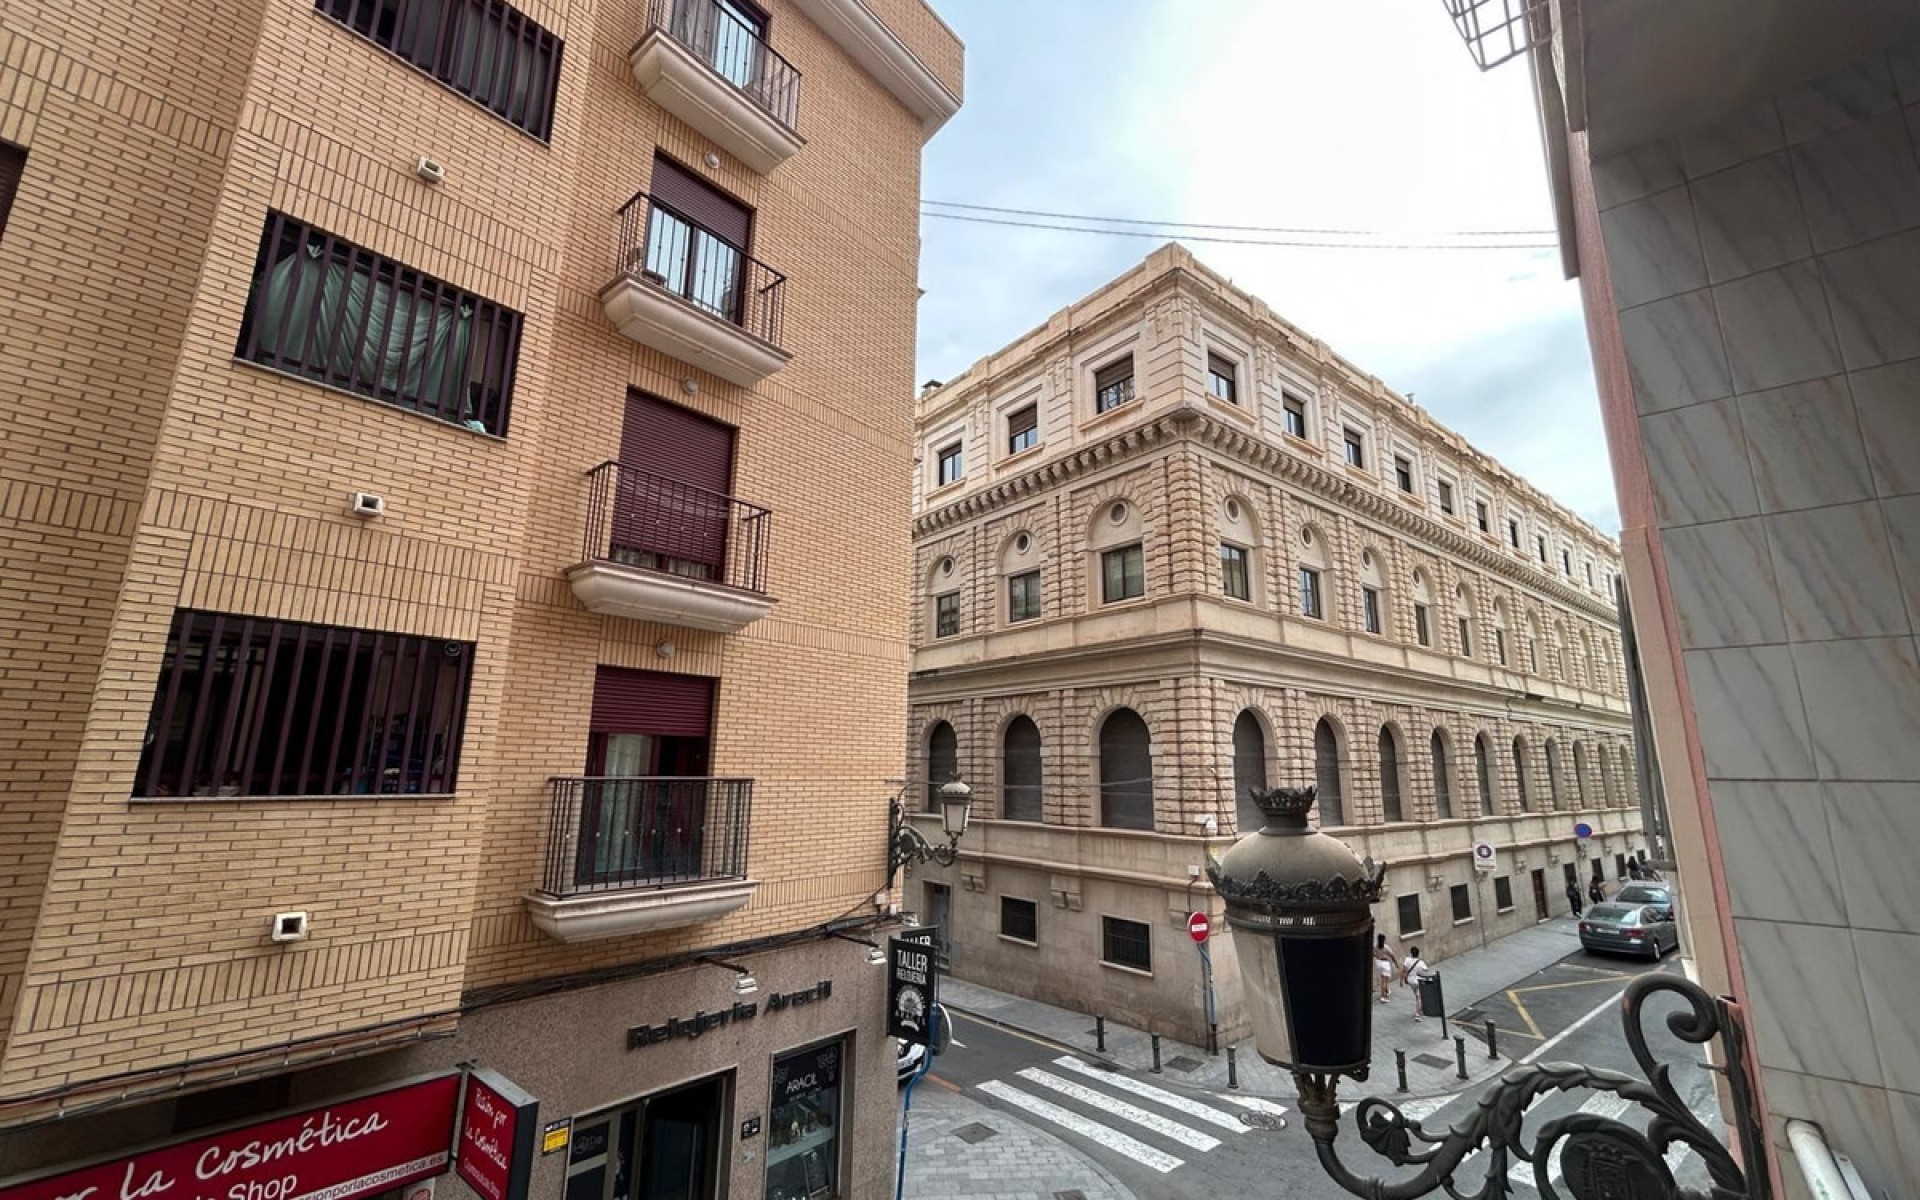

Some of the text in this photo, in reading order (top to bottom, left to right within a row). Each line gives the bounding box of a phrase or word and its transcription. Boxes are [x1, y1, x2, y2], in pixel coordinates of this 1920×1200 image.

[896, 948, 928, 972] TALLER
[195, 1111, 389, 1180] Cosmética
[228, 1174, 297, 1200] Shop
